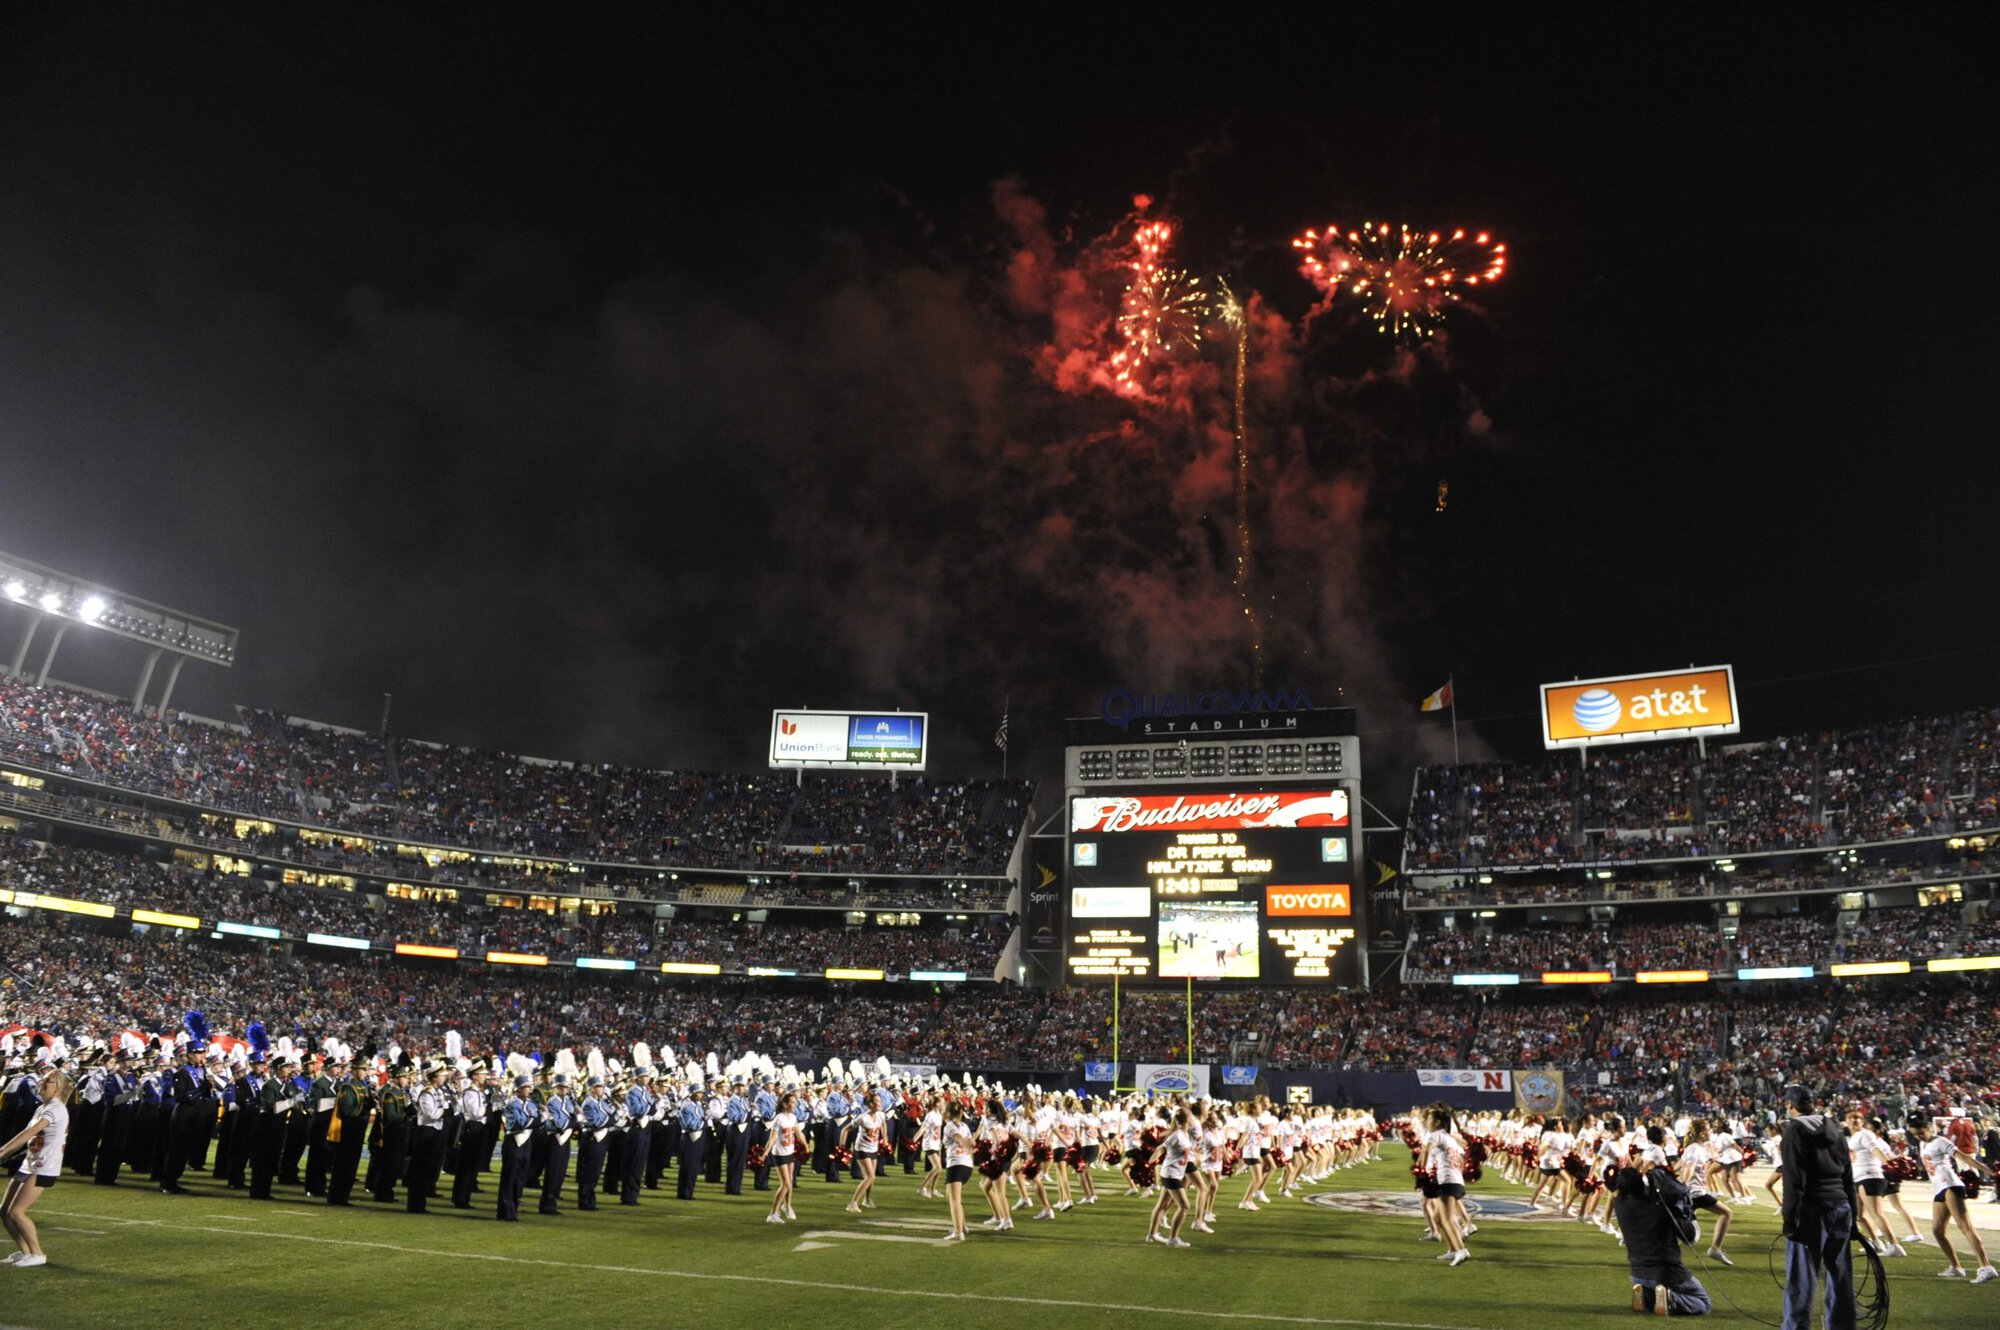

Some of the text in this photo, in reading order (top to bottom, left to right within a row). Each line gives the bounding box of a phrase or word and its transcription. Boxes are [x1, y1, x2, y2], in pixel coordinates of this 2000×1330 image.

[1101, 687, 1314, 732] QUALCOMM
[1629, 684, 1709, 720] at&t
[1143, 716, 1297, 732] STADIUM
[851, 750, 874, 759] ready.
[1094, 793, 1280, 833] Budweiser
[1166, 845, 1247, 859] DR PEPPER
[1147, 859, 1273, 874] HALFTIME SHOW
[1030, 891, 1060, 904] Sprint
[1270, 893, 1347, 909] TOYOTA
[1153, 1070, 1177, 1080] PACIFIC
[1483, 1071, 1504, 1090] N
